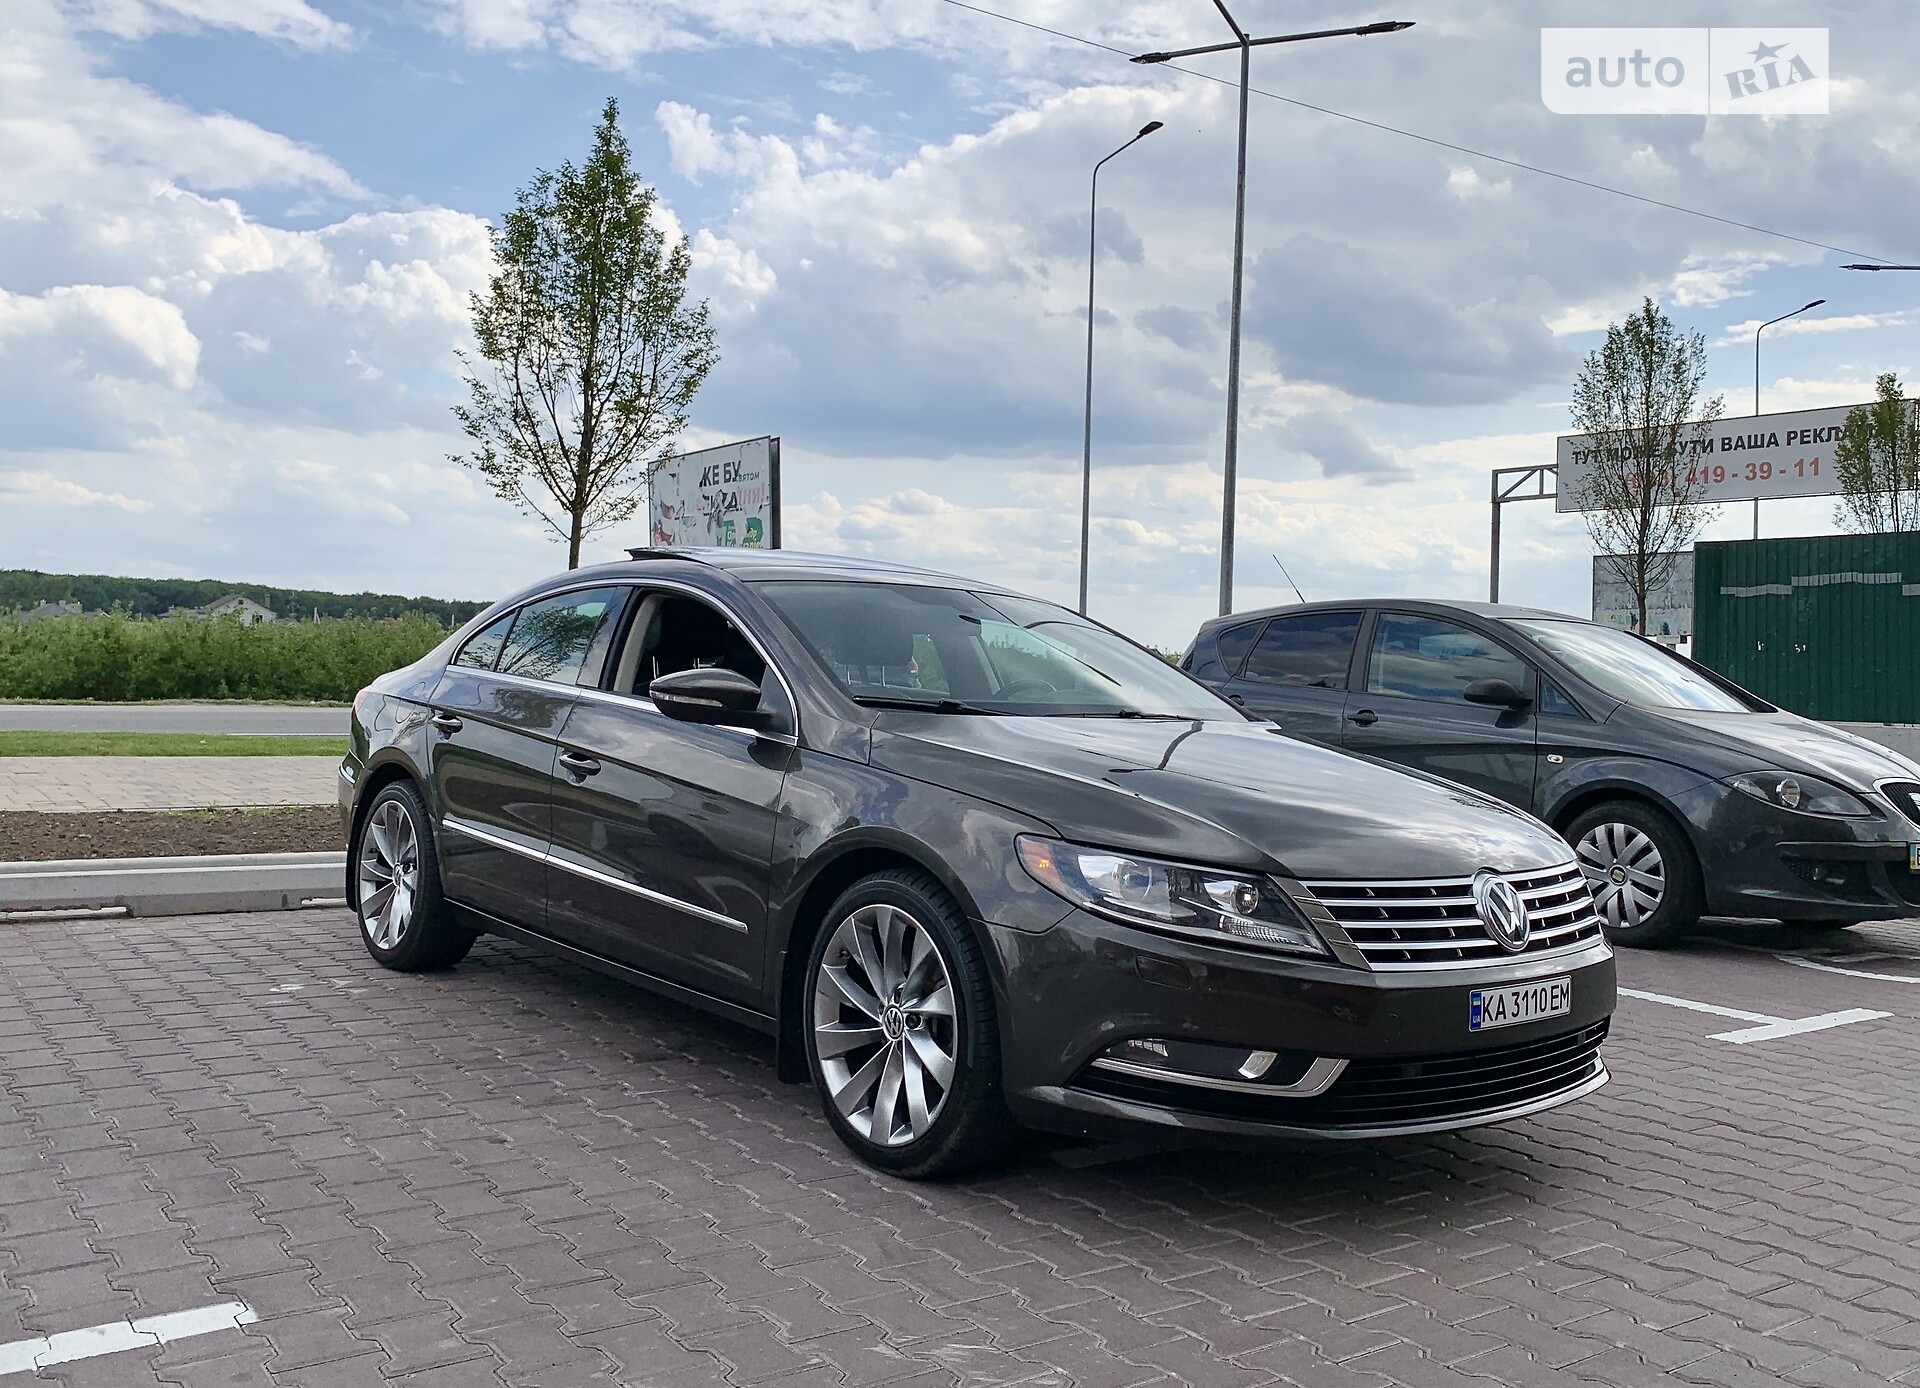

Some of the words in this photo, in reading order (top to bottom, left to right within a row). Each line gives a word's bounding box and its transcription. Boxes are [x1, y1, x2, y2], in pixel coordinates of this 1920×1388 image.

[1721, 430, 1780, 452] ВАША
[1745, 461, 1772, 481] 39
[1794, 457, 1820, 477] 11
[1481, 993, 1507, 1023] KA
[1511, 986, 1548, 1018] 3110
[1550, 982, 1570, 1011] EM
